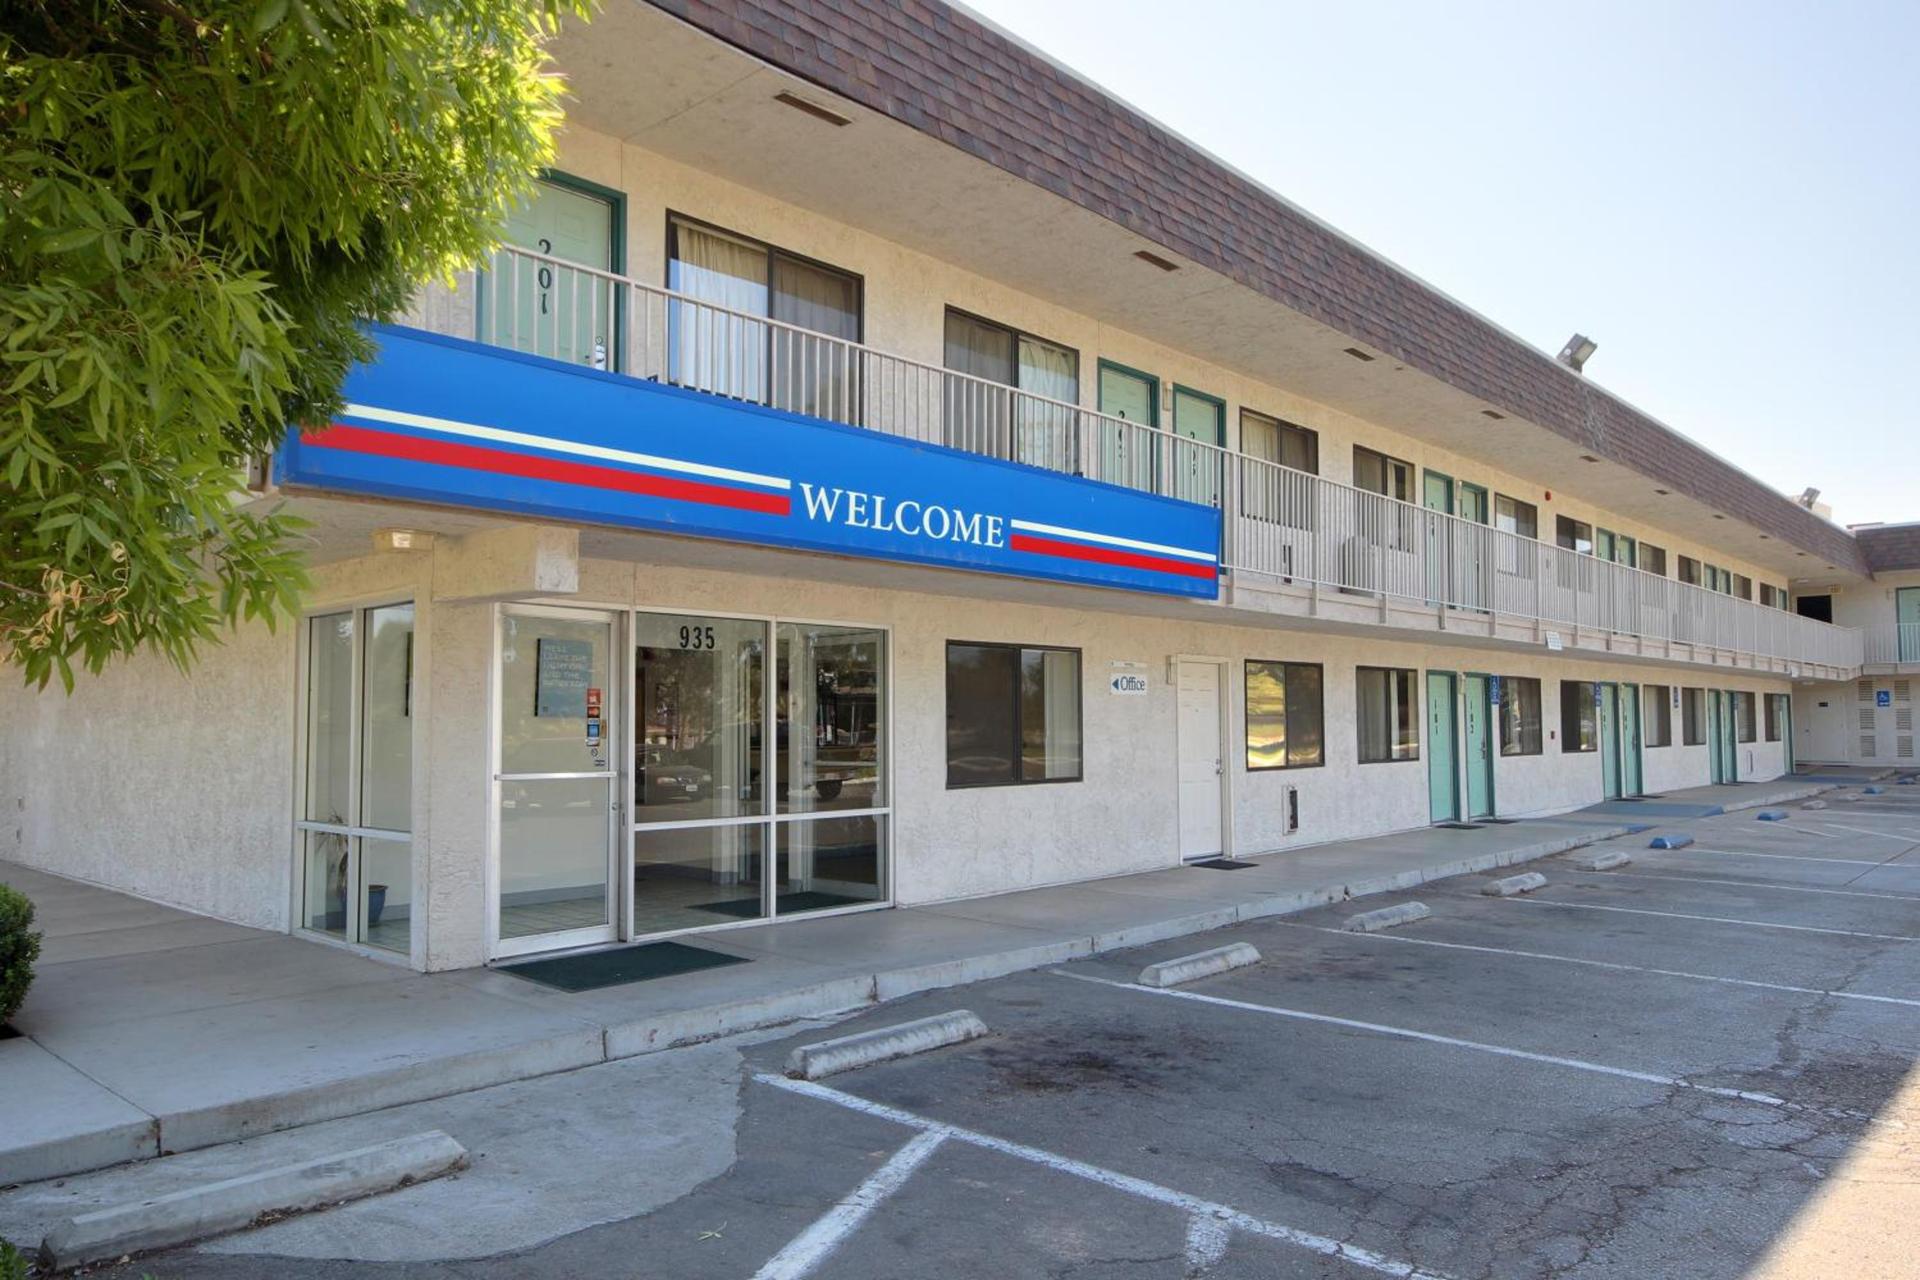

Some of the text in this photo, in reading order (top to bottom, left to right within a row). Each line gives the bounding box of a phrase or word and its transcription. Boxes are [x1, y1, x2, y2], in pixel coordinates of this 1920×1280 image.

[538, 238, 552, 315] 201
[799, 482, 1005, 548] WELCOME
[679, 625, 715, 650] 935
[1120, 675, 1145, 691] Office
